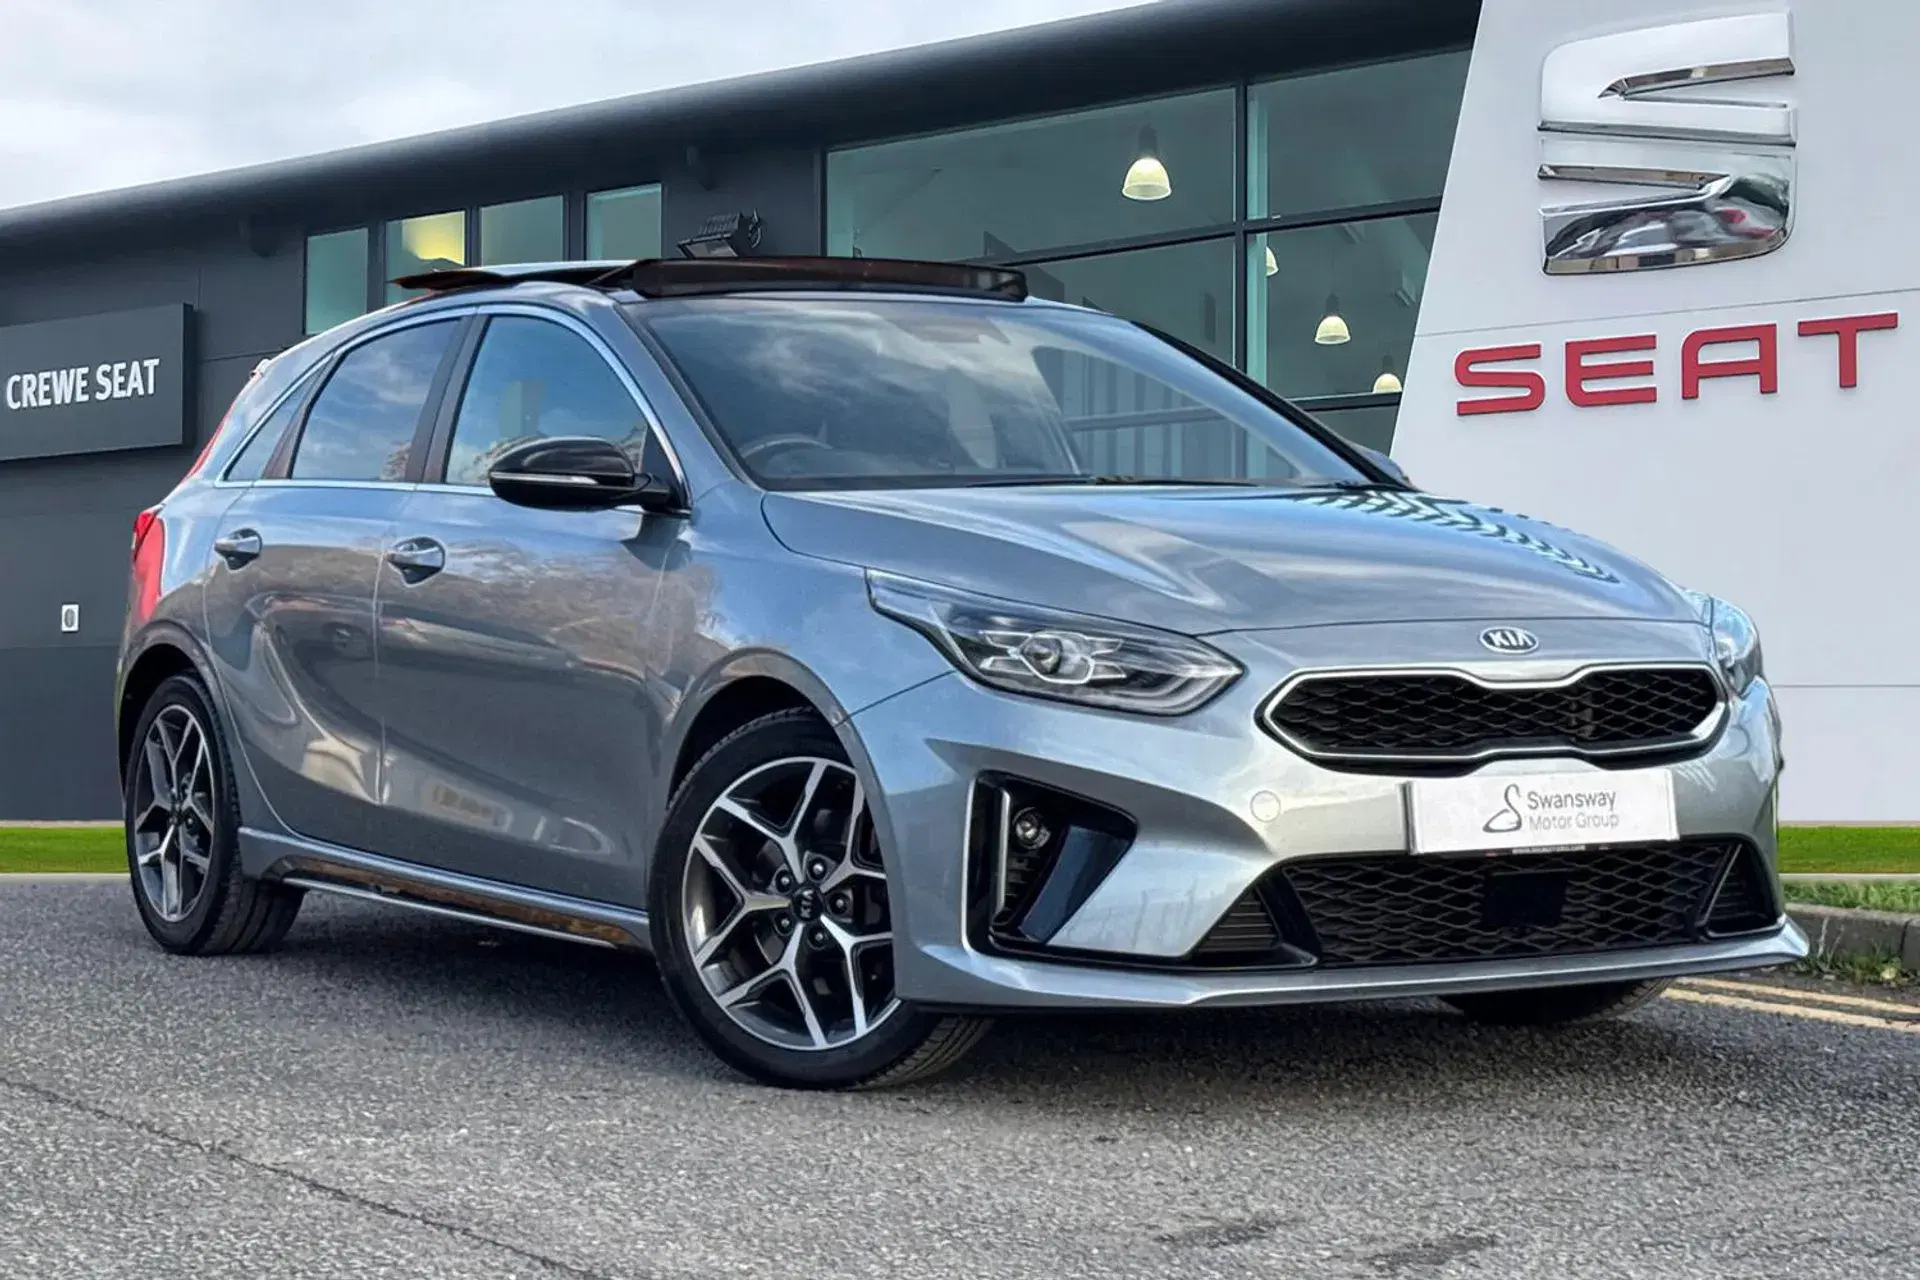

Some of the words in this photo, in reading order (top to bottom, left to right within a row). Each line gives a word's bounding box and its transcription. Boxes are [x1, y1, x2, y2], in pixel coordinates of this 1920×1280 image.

[1454, 311, 1899, 416] SEAT
[6, 367, 89, 409] CREWE
[95, 358, 160, 401] SEAT
[1488, 630, 1533, 647] KIA
[1527, 790, 1616, 811] Swansway
[1528, 815, 1572, 830] Motor
[1575, 811, 1620, 829] Group
